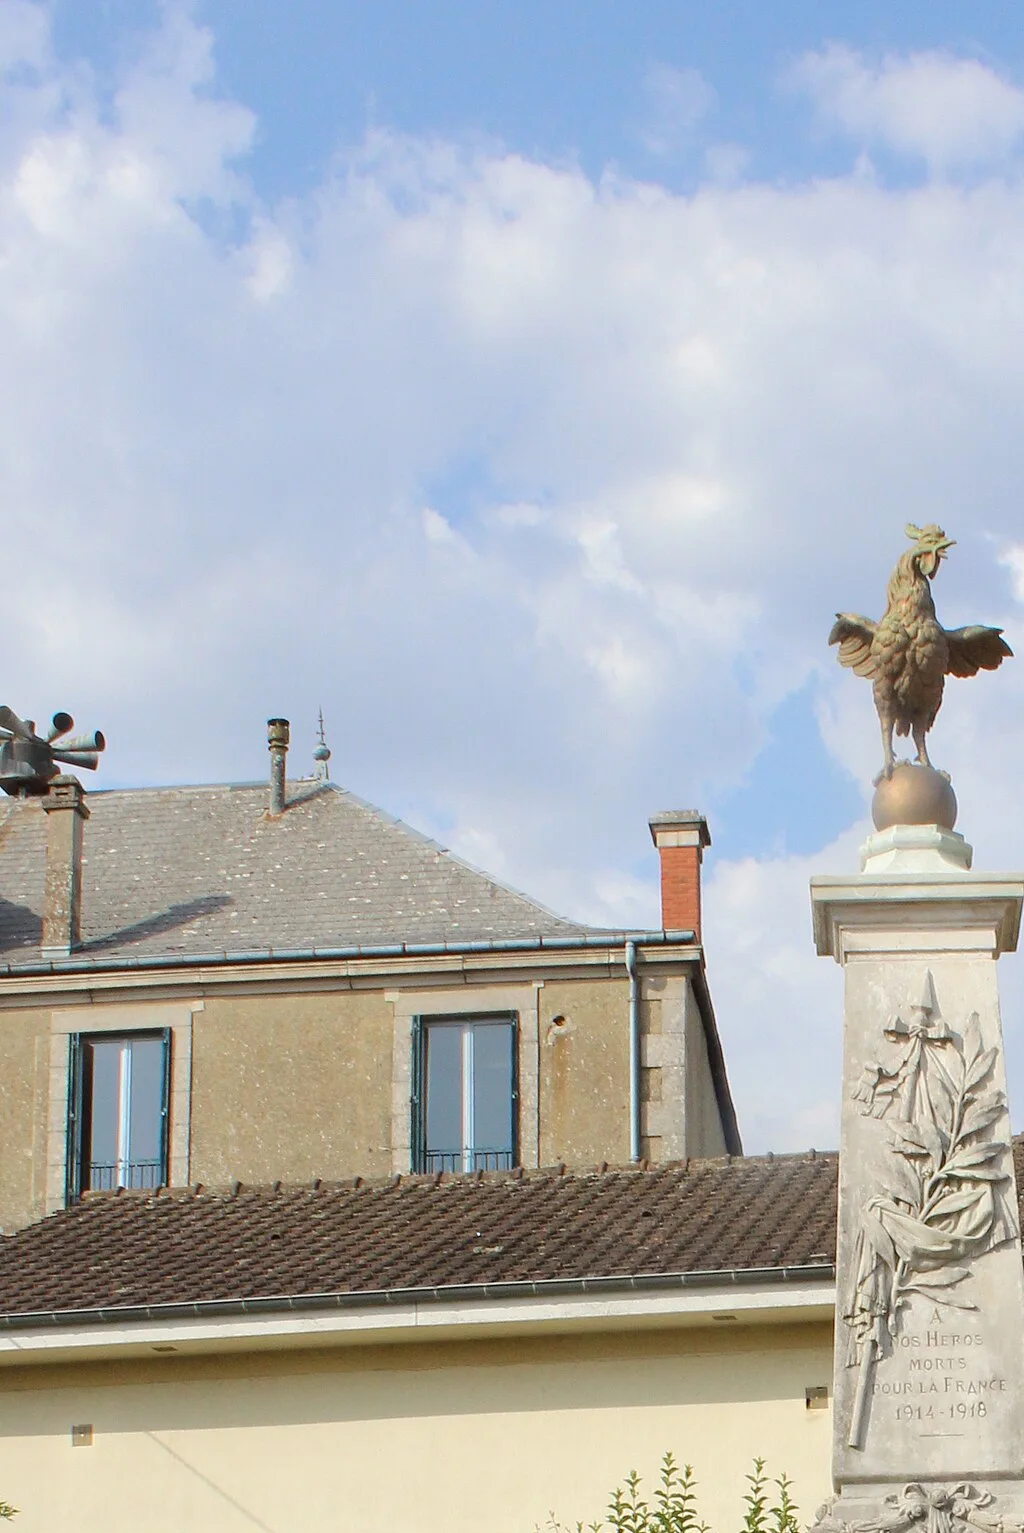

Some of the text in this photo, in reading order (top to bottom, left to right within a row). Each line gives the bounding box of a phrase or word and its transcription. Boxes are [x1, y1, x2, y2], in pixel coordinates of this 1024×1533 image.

[929, 1308, 943, 1324] A
[910, 1358, 967, 1371] MORTS
[873, 1383, 912, 1394] POUR
[943, 1377, 1007, 1395] FRANCE
